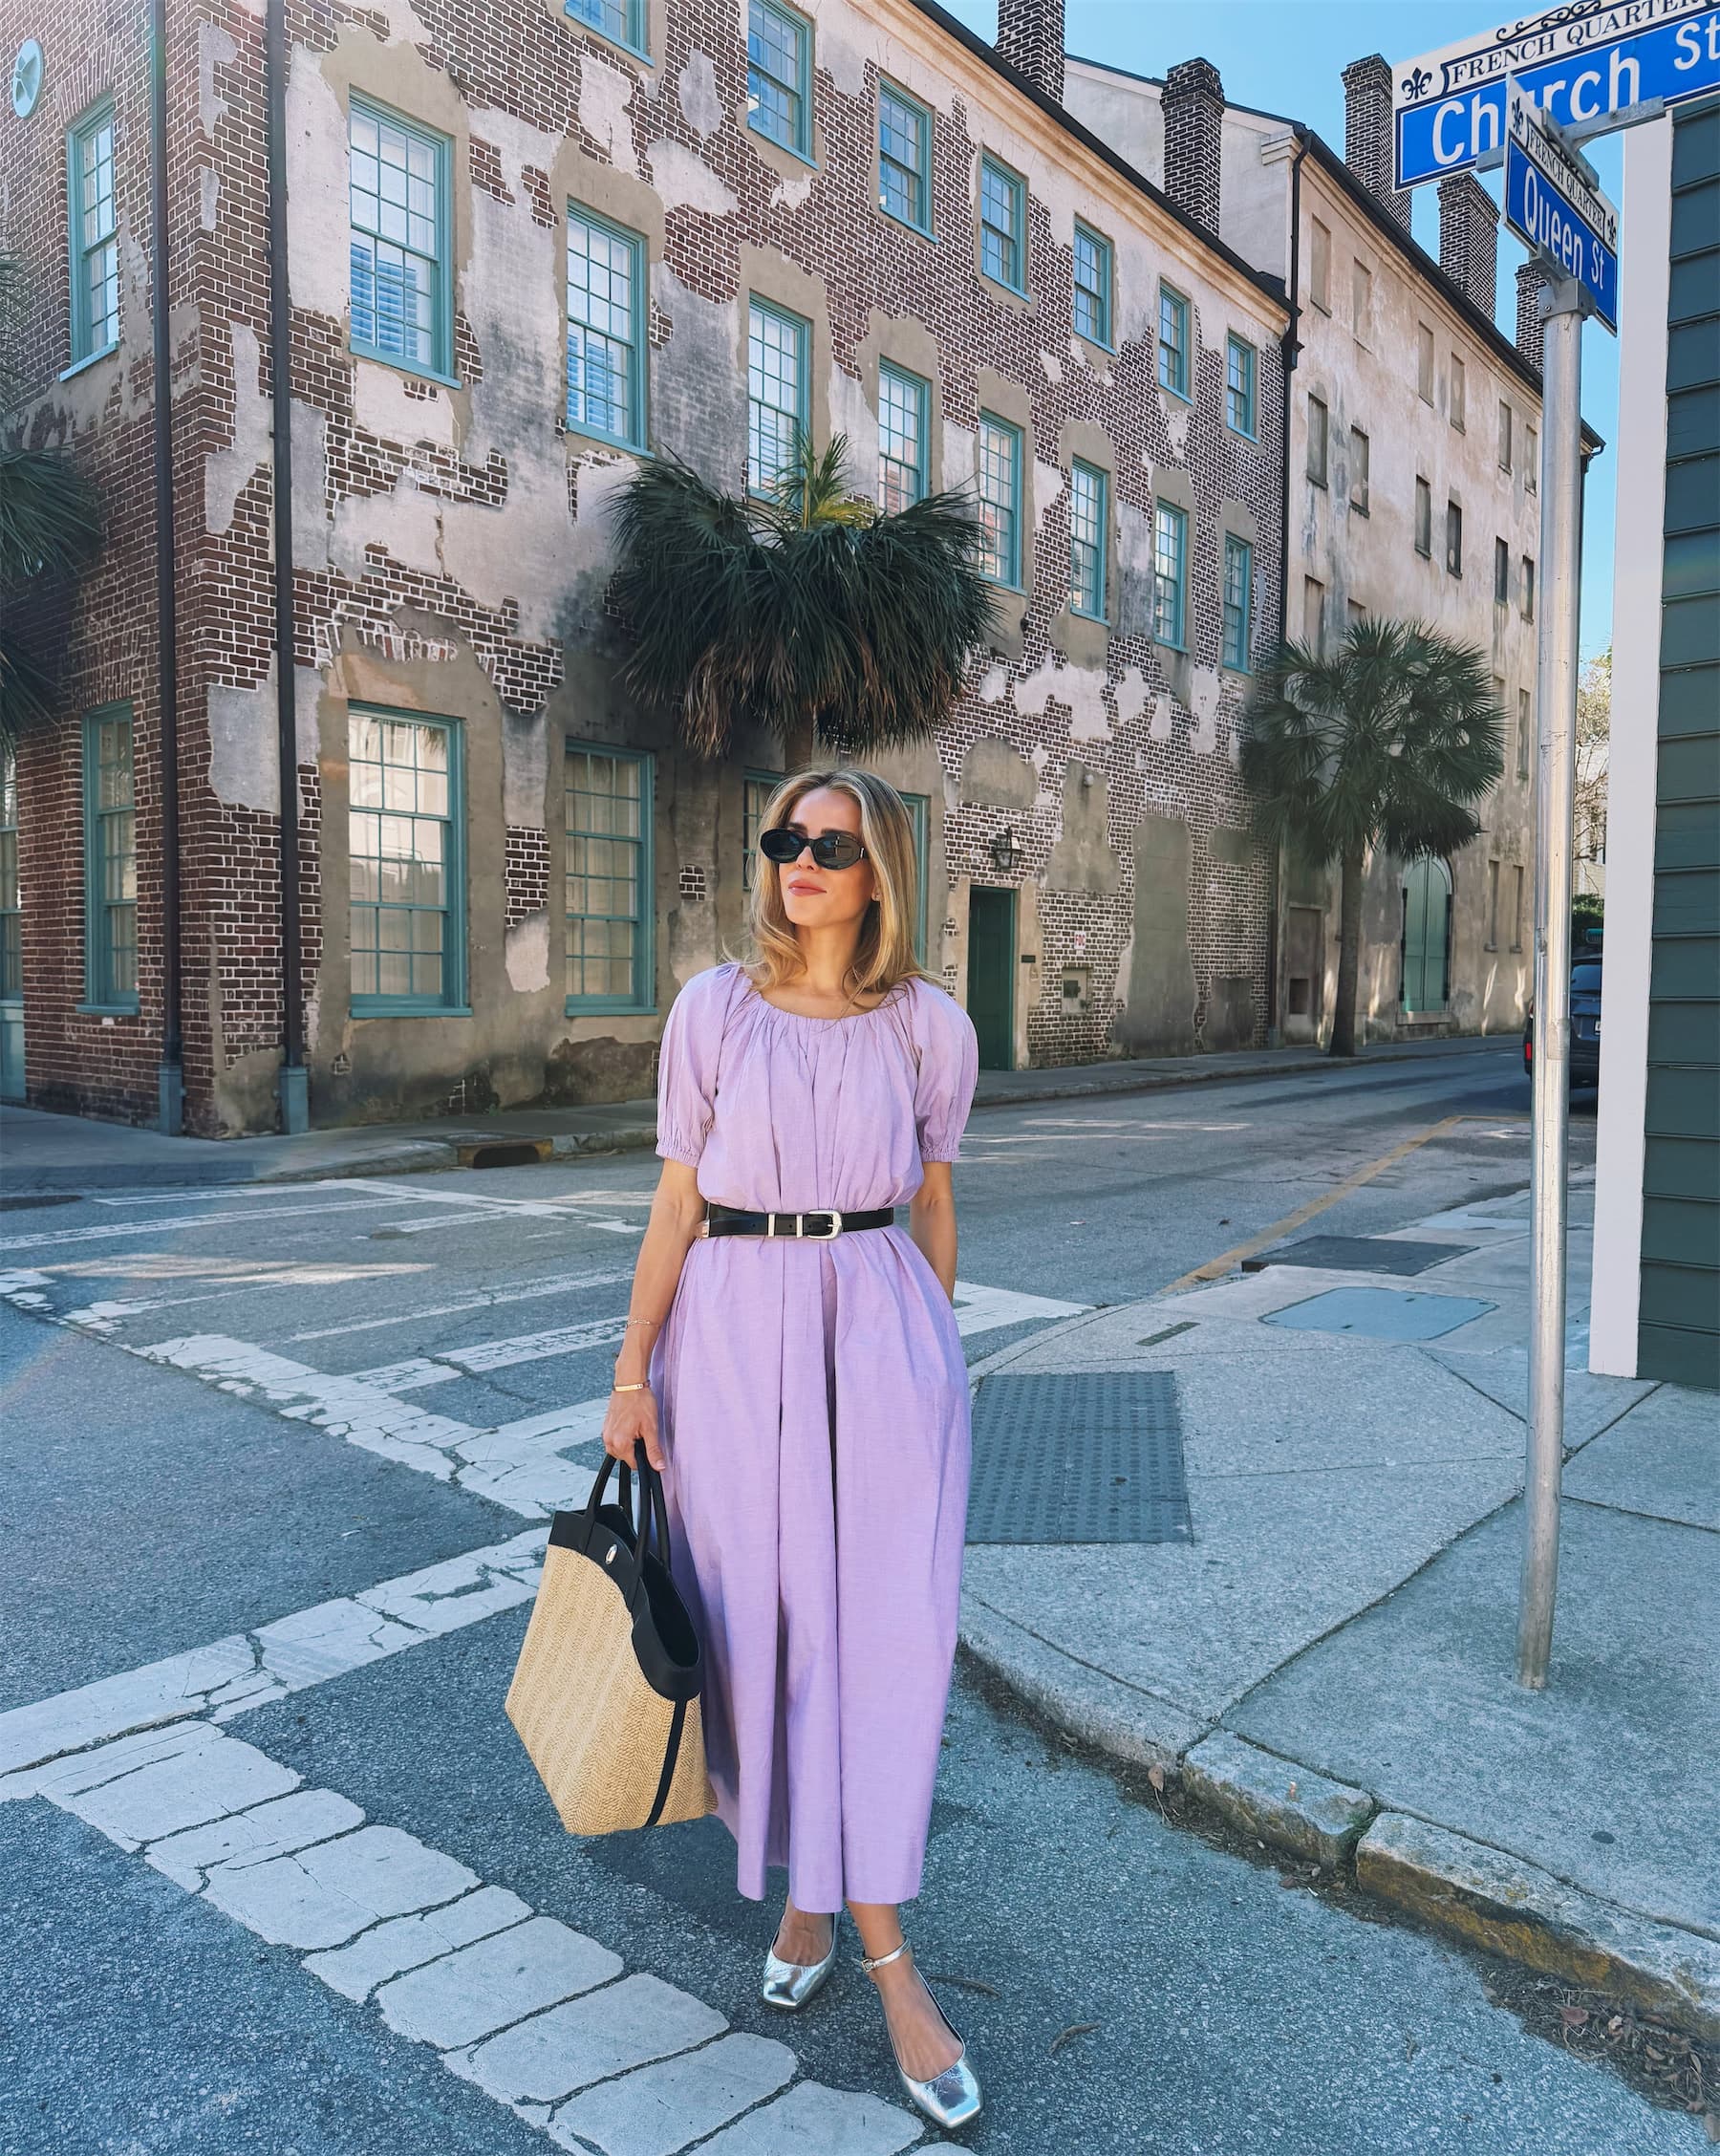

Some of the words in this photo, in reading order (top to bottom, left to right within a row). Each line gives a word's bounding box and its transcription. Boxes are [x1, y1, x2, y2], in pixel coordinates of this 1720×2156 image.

[1432, 47, 1640, 164] Chrch
[1674, 15, 1720, 70] St
[1452, 32, 1557, 84] FRENCH
[1524, 166, 1582, 280] Queen
[1591, 241, 1604, 291] St
[1530, 128, 1564, 184] FRENCH
[1567, 174, 1602, 227] QUARTER
